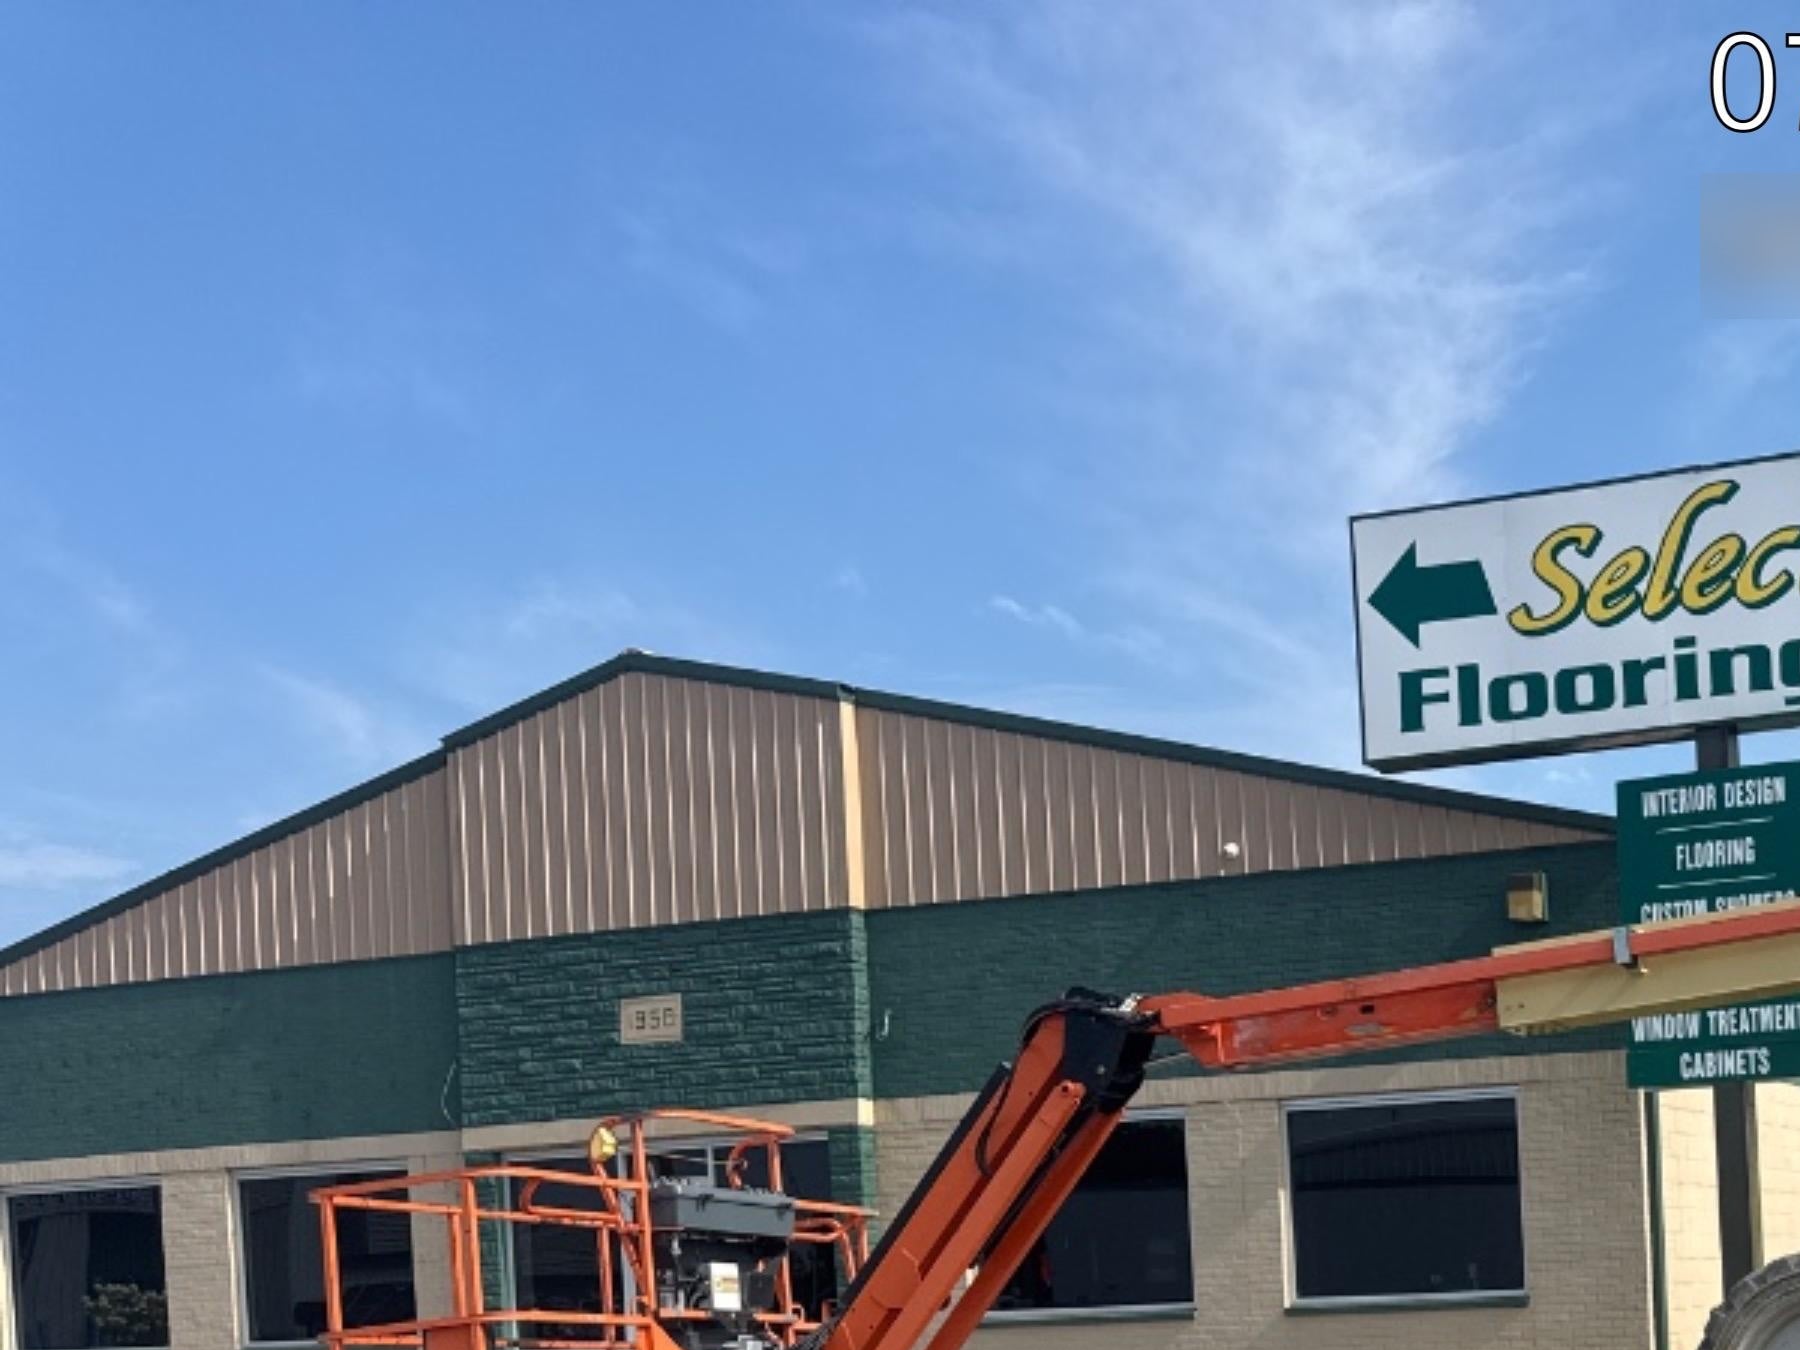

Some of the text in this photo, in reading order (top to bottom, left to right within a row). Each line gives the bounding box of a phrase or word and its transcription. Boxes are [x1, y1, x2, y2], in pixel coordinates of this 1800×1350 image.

[1640, 775, 1787, 819] INTERIOR DESIGN
[1675, 835, 1757, 871] FLOORING
[1631, 1011, 1701, 1043] WINDOW
[1678, 1046, 1772, 1080] CABINETS
